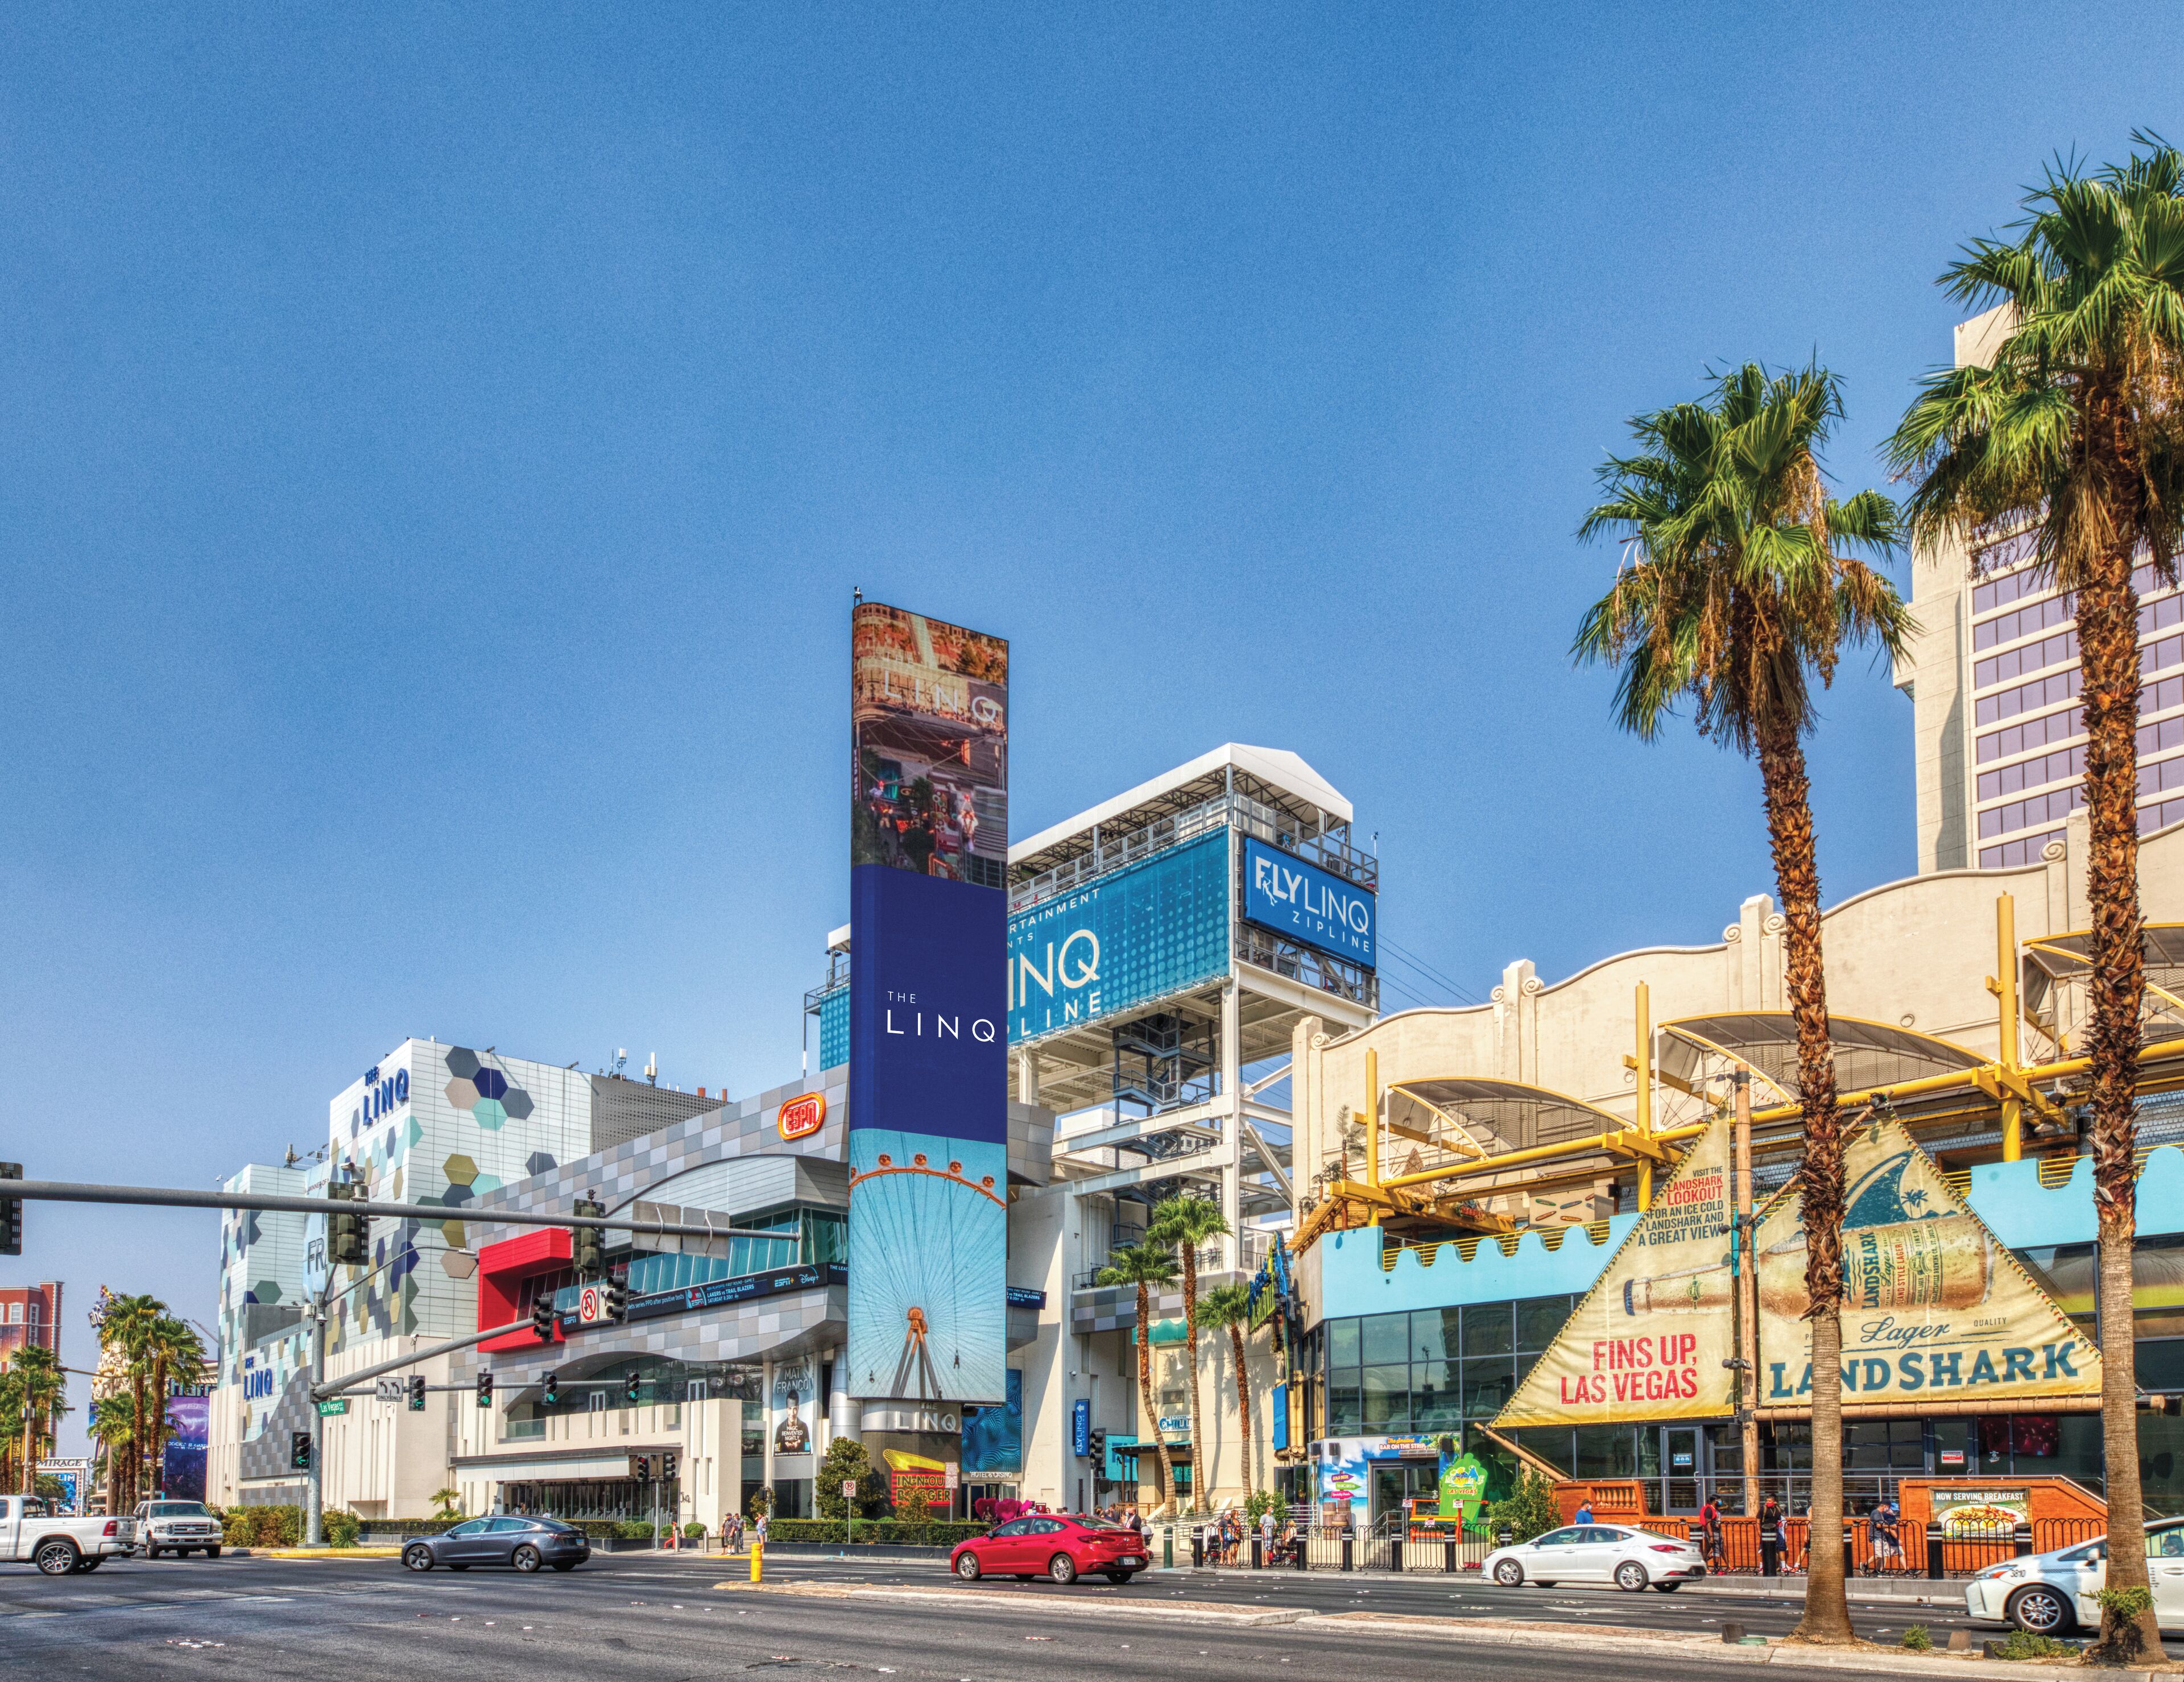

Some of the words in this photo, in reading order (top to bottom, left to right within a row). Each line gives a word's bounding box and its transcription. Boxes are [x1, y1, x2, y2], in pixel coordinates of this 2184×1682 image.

[884, 670, 996, 724] LINQ
[1009, 888, 1100, 934] RTAINMENT
[1292, 910, 1370, 953] ZIPLINE
[887, 991, 916, 1004] THE
[887, 1009, 995, 1042] LINQ
[363, 1068, 410, 1126] LINQ
[785, 1101, 816, 1131] ESPN
[1693, 1169, 1709, 1177] VISIT
[1667, 1174, 1723, 1192] LANDSHARK
[1667, 1185, 1723, 1206] LOOKOUT
[1649, 1208, 1668, 1219] FOR
[1670, 1206, 1682, 1216] AN
[1684, 1204, 1698, 1215] ICE
[1700, 1200, 1724, 1212] COLD
[1645, 1215, 1702, 1232] LANDSHARK
[1705, 1211, 1724, 1224] AND
[1638, 1233, 1646, 1247] A
[1649, 1228, 1687, 1246] GREAT
[1895, 1244, 1905, 1263] LAGER
[1860, 1232, 1880, 1310] LANDSHARK
[1879, 1249, 1895, 1287] Lager
[1896, 1265, 1906, 1286] STYLE
[662, 1295, 675, 1304] positive
[1896, 1287, 1905, 1306] ISLAND
[564, 1316, 576, 1325] ESPN
[1974, 1317, 2007, 1327] QUALITY
[1860, 1316, 1950, 1349] Lager
[1593, 1337, 1653, 1372] FINS
[1660, 1333, 1697, 1366] UP,
[784, 1367, 801, 1380] MAT
[243, 1368, 273, 1400] LINQ
[777, 1378, 809, 1394] FRANCO
[1560, 1374, 1607, 1405] LAS
[1612, 1368, 1698, 1403] VEGAS
[327, 1401, 340, 1414] Vegas
[919, 1402, 938, 1410] THE
[895, 1411, 957, 1432] LINQ
[1159, 1416, 1189, 1430] CHILL
[896, 1474, 946, 1488] IN-N-OU
[896, 1489, 951, 1502] BGER
